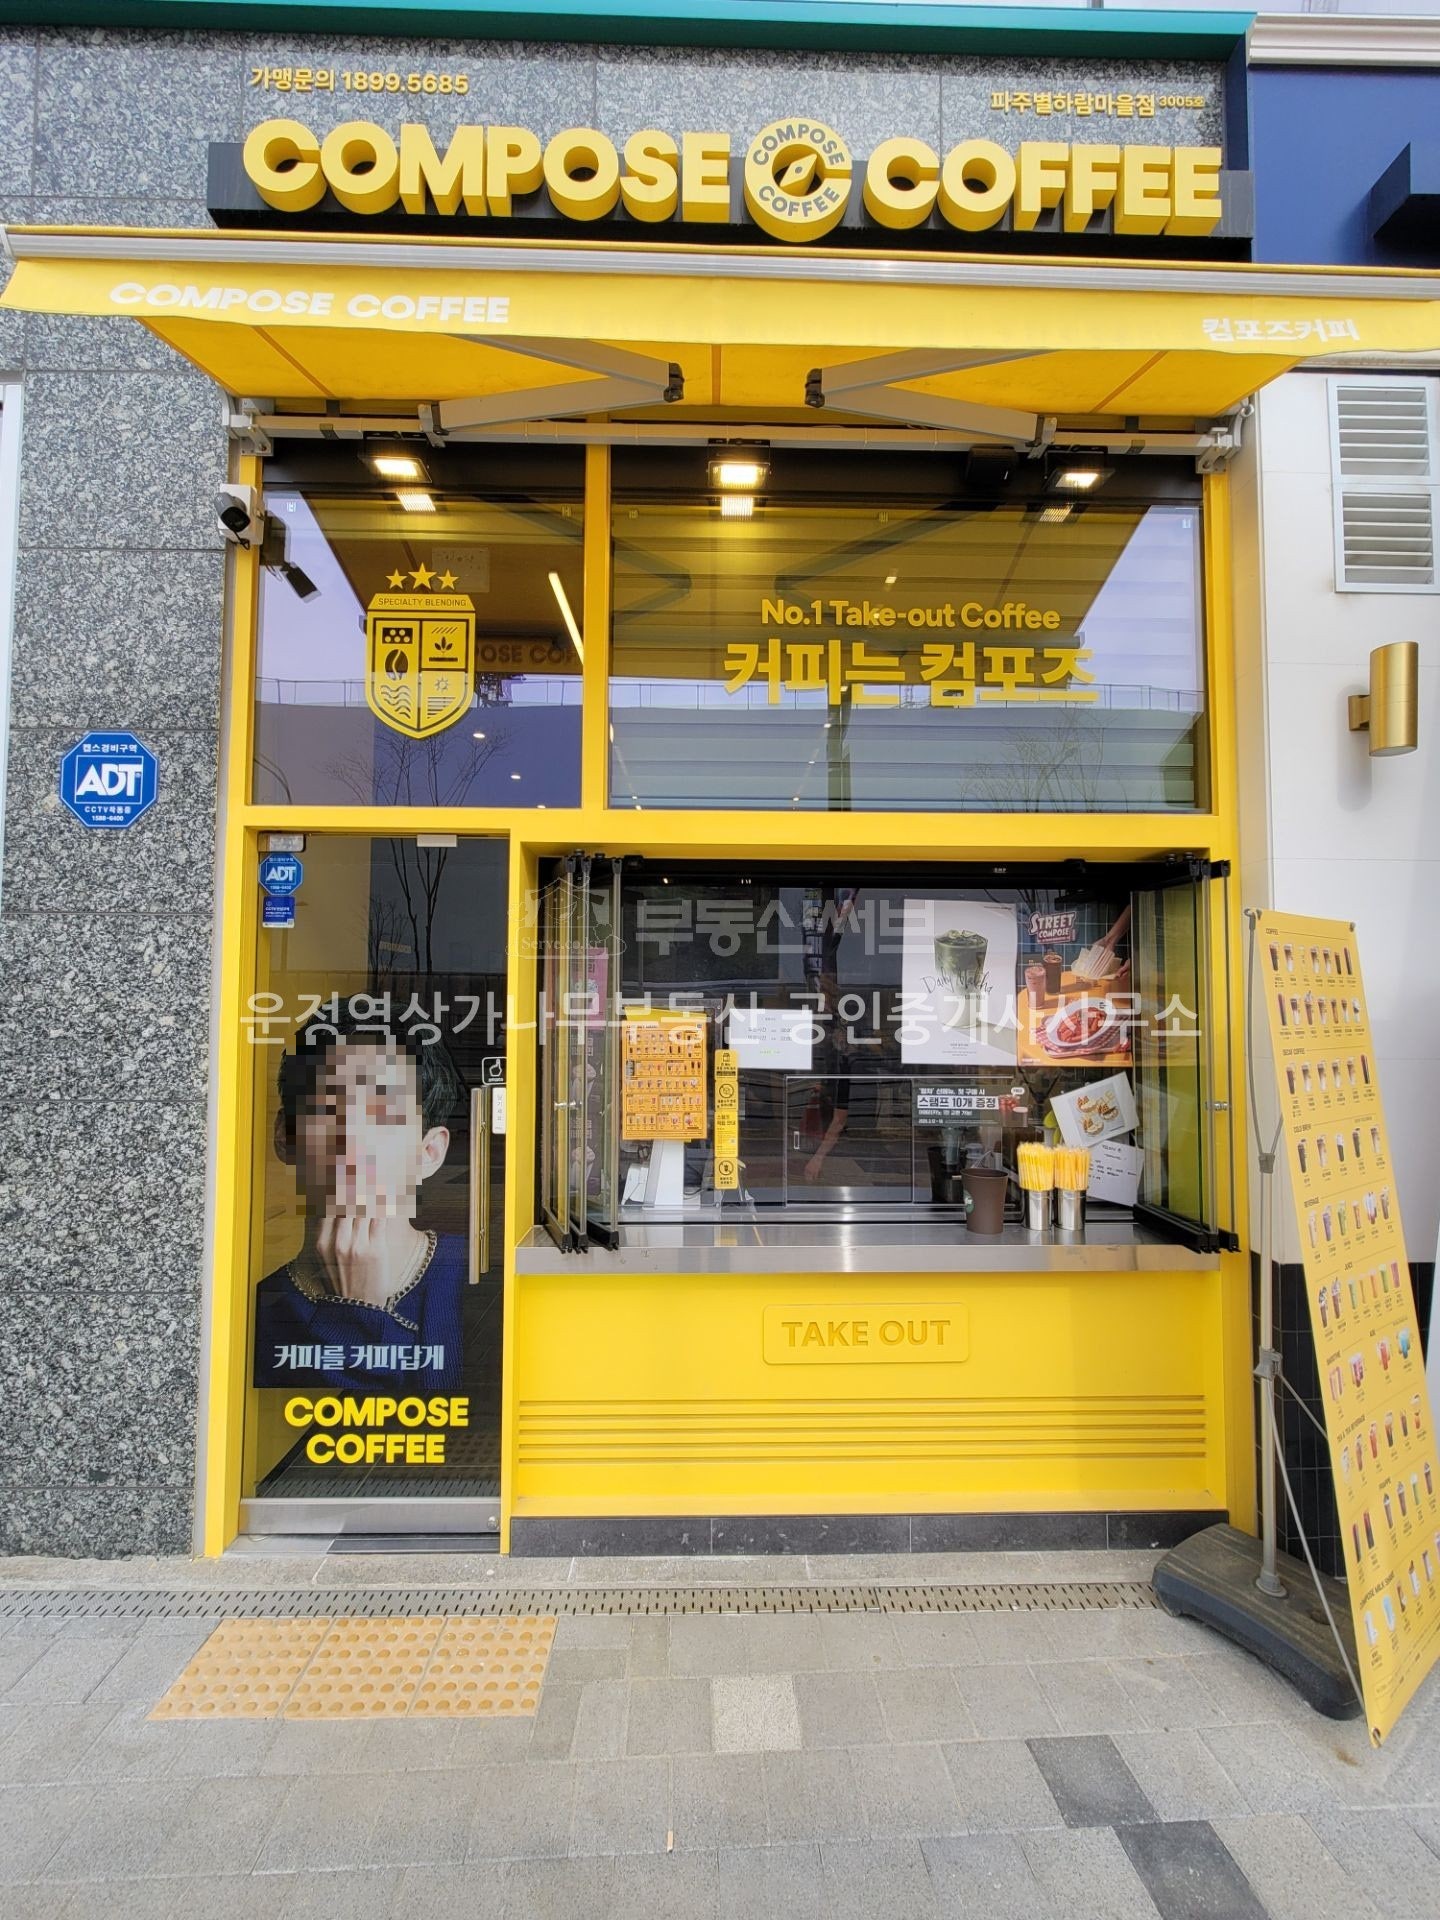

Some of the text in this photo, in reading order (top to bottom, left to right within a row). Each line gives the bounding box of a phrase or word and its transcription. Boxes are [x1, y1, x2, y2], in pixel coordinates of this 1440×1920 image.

[250, 67, 469, 95] 가맹문의 1899.5685
[990, 91, 1206, 118] 파주별하람마을점 3005호
[752, 123, 845, 166] COMPOSE
[243, 119, 1221, 235] COMPOSE COFFEE
[758, 184, 840, 218] COFFEE
[109, 282, 511, 324] COMPOSE COFFEE
[1202, 317, 1361, 343] 컴포즈커피
[378, 598, 467, 607] SPECIALTY BLENDING
[761, 599, 1061, 630] No.1 Take-out Coffee
[723, 638, 1099, 708] 커피는 컴포즈
[76, 763, 142, 797] ADT
[265, 865, 297, 881] ADT
[1031, 913, 1075, 936] STREET
[1038, 928, 1071, 938] COMPOSE
[918, 1096, 997, 1109] 스탬프 10개 증정
[781, 1320, 951, 1347] TAKE OUT
[272, 1345, 445, 1370] 커피를 커피답게
[284, 1397, 469, 1427] COMPOSE
[306, 1434, 446, 1464] COFFEE
